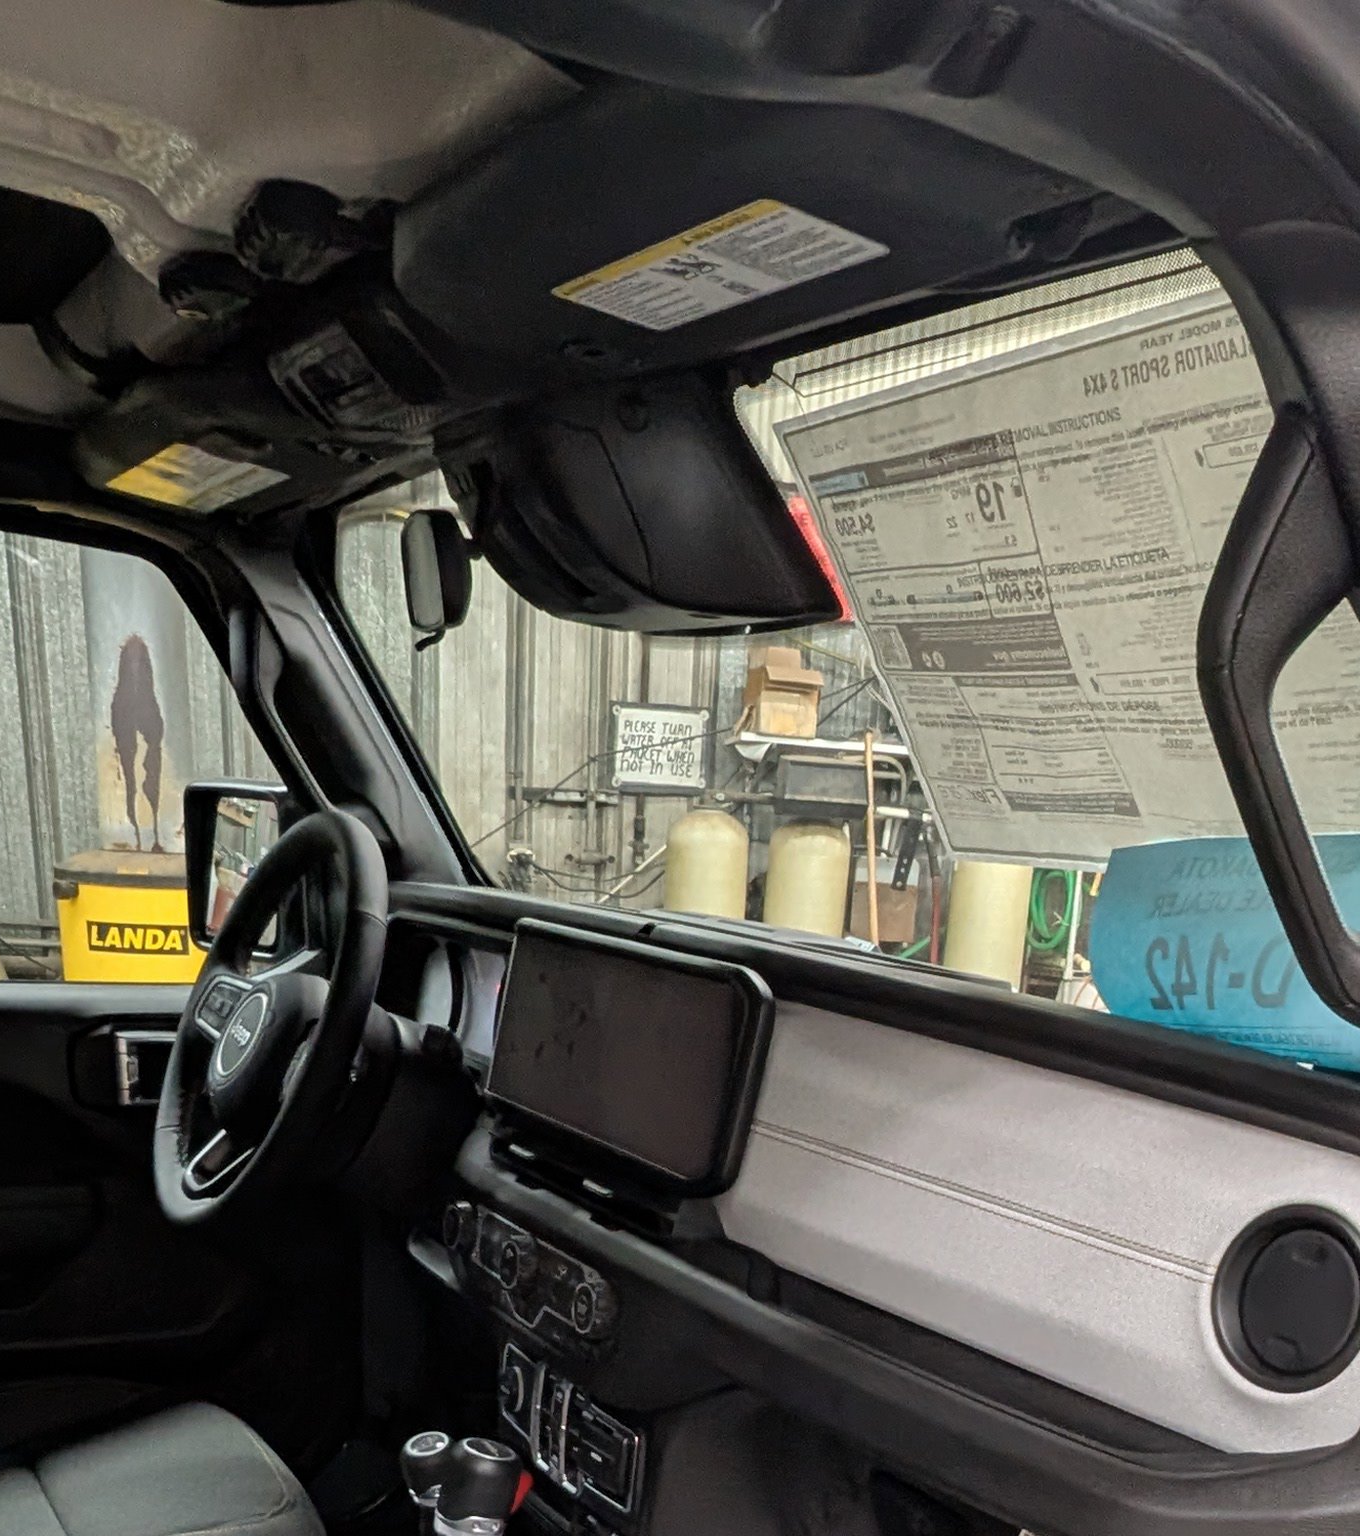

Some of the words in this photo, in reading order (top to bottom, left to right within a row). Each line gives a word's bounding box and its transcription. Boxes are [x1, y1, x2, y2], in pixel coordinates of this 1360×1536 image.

[1048, 406, 1122, 436] INSTRUCTIONS
[624, 720, 657, 734] PLEASE
[662, 723, 692, 736] TURN
[621, 734, 655, 747] WATER
[670, 763, 693, 778] USE
[90, 925, 183, 951] LANDA
